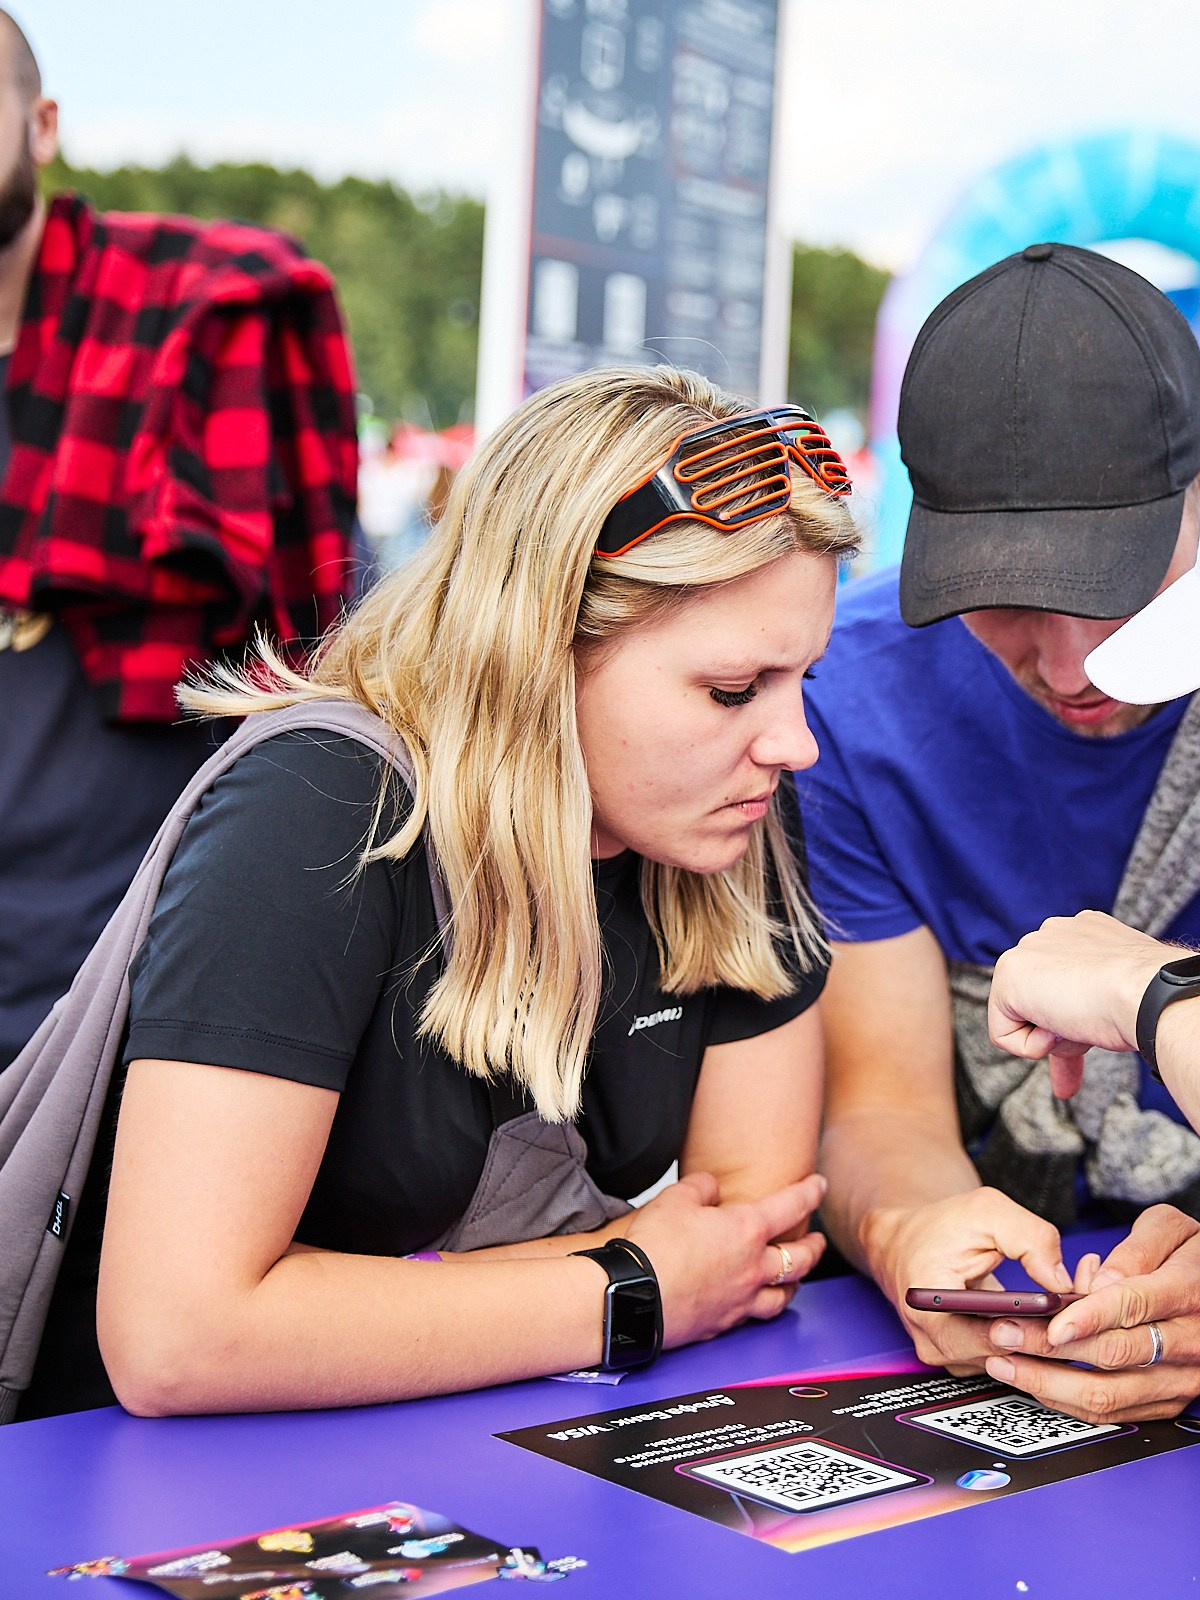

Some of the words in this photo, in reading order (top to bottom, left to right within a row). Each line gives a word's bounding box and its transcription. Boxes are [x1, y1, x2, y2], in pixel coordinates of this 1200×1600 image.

[880, 1390, 930, 1403] Альфа
[929, 1384, 965, 1393] Visa
[831, 1401, 883, 1416] Банка
[852, 1399, 925, 1417] стильные
[546, 1424, 614, 1441] VISA
[716, 1427, 768, 1440] Extra
[764, 1420, 805, 1430] Visa
[645, 1424, 747, 1447] промокоды.
[734, 1425, 814, 1444] Скачайте
[614, 1441, 703, 1464] получайте
[630, 1442, 735, 1467] приложение
